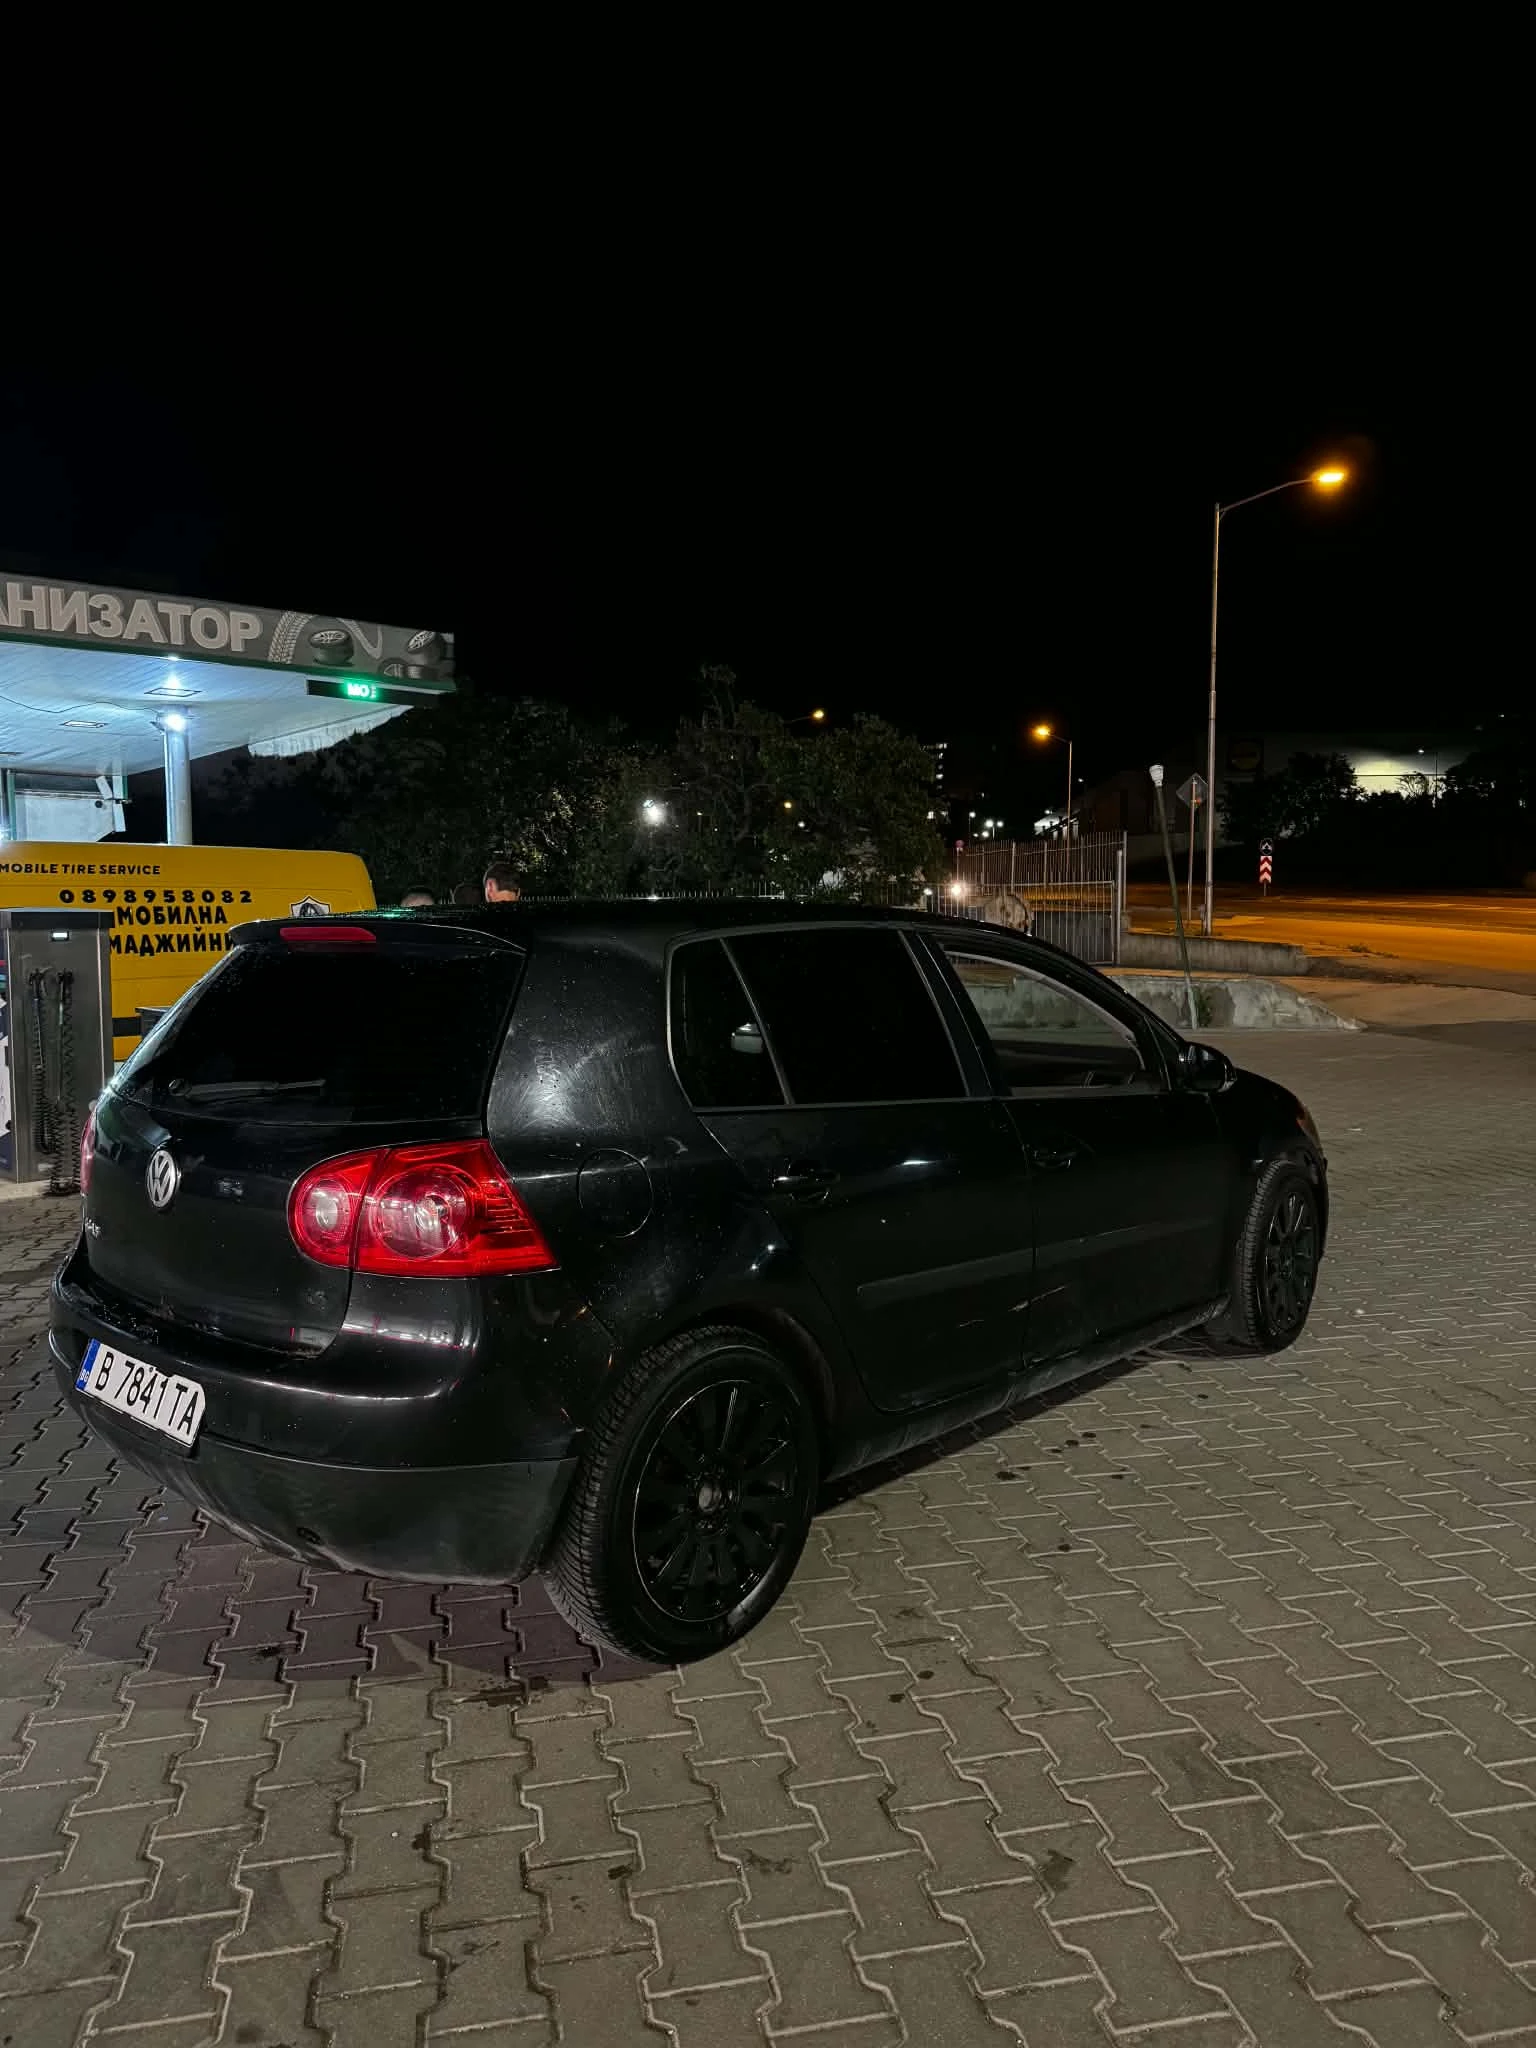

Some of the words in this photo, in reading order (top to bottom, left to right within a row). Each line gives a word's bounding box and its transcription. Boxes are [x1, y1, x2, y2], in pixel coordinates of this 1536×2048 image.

[0, 863, 59, 874] MOBILE
[62, 864, 97, 875] TIRE
[99, 864, 161, 875] SERVICE
[59, 889, 252, 904] 0898958082
[117, 905, 228, 926] МОБИЛНА
[95, 1351, 115, 1391] B
[114, 1360, 169, 1419] 7841
[169, 1382, 199, 1436] TA
